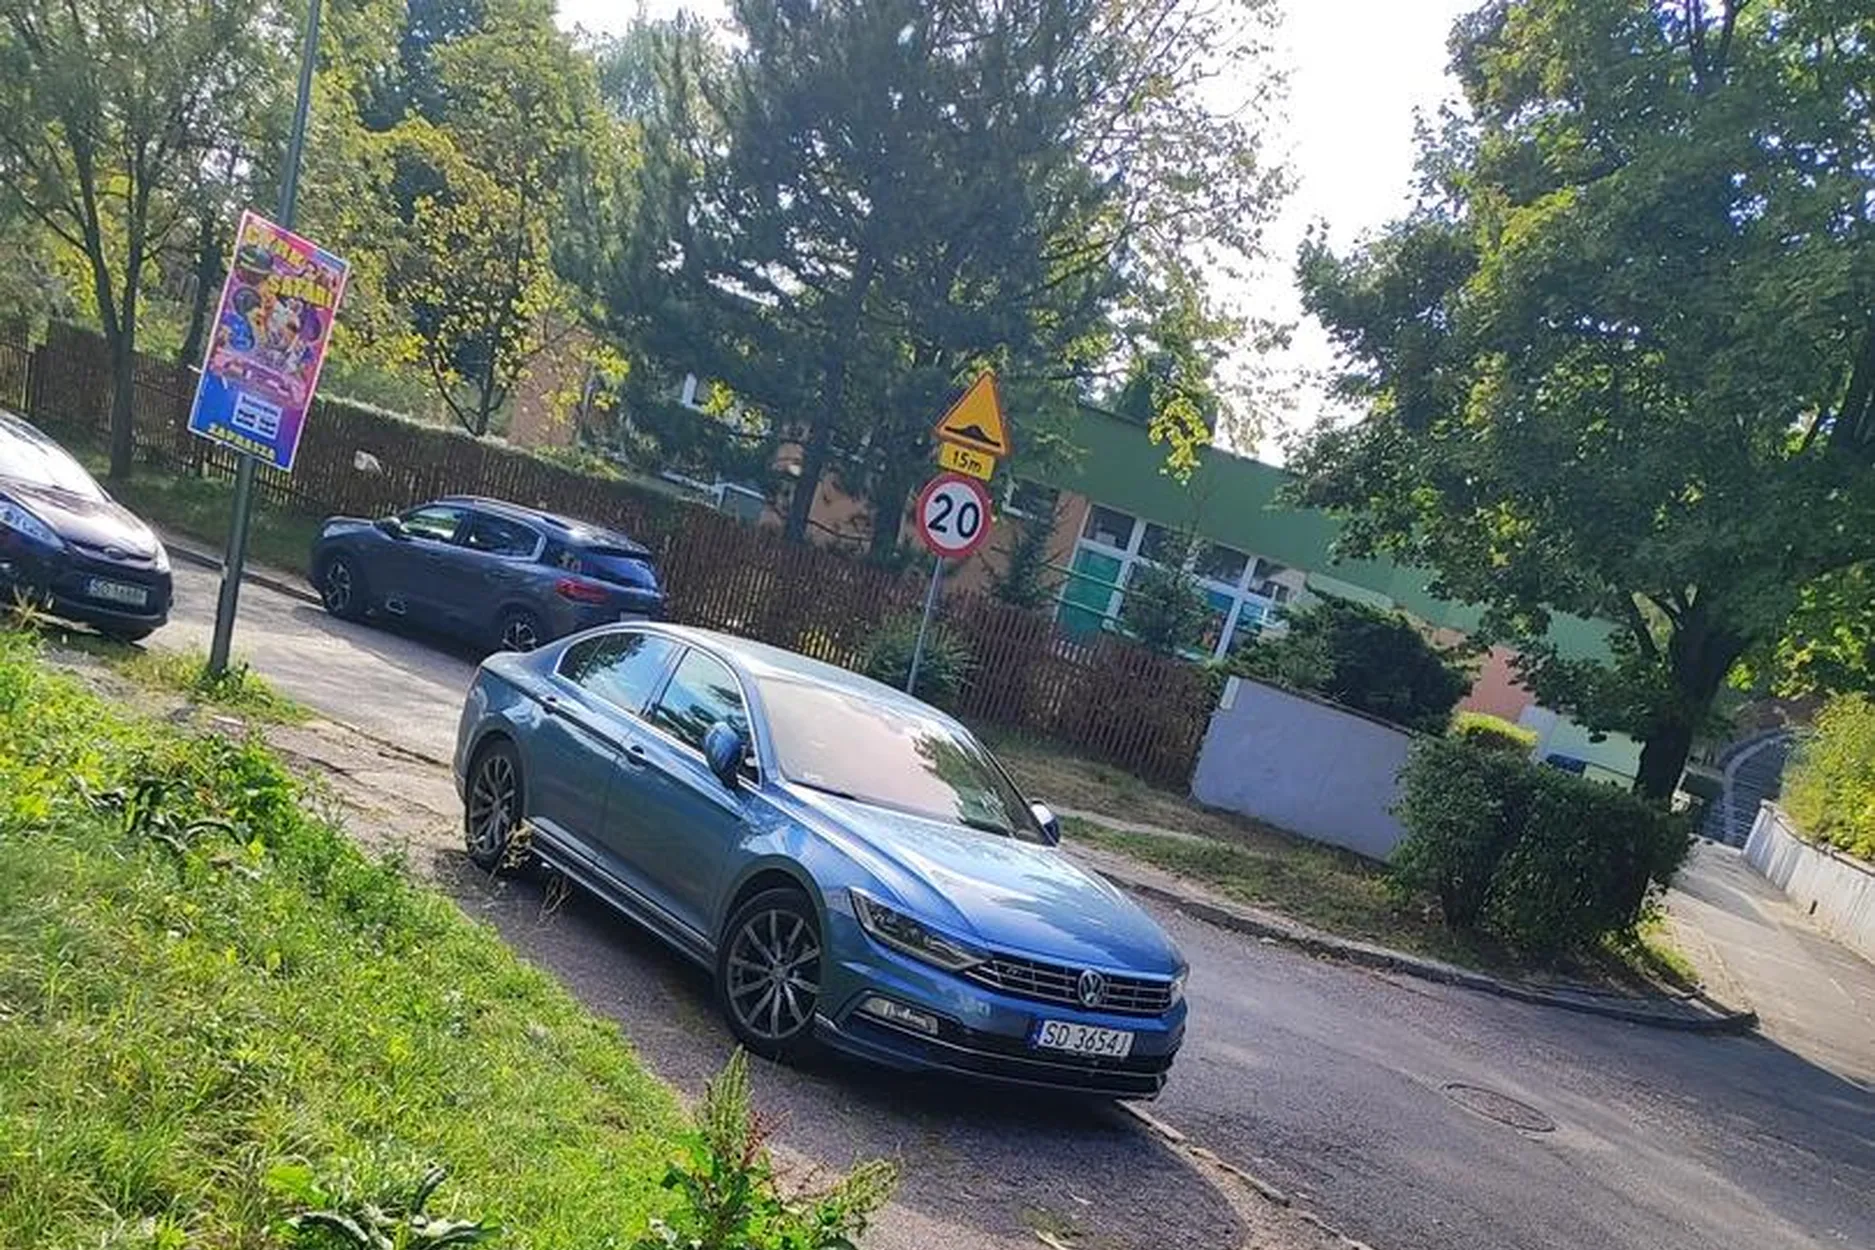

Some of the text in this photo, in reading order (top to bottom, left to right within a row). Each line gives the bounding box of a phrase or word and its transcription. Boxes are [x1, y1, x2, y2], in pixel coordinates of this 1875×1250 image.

[952, 450, 983, 474] 15m
[928, 493, 980, 539] 20
[1043, 1023, 1070, 1047] SD
